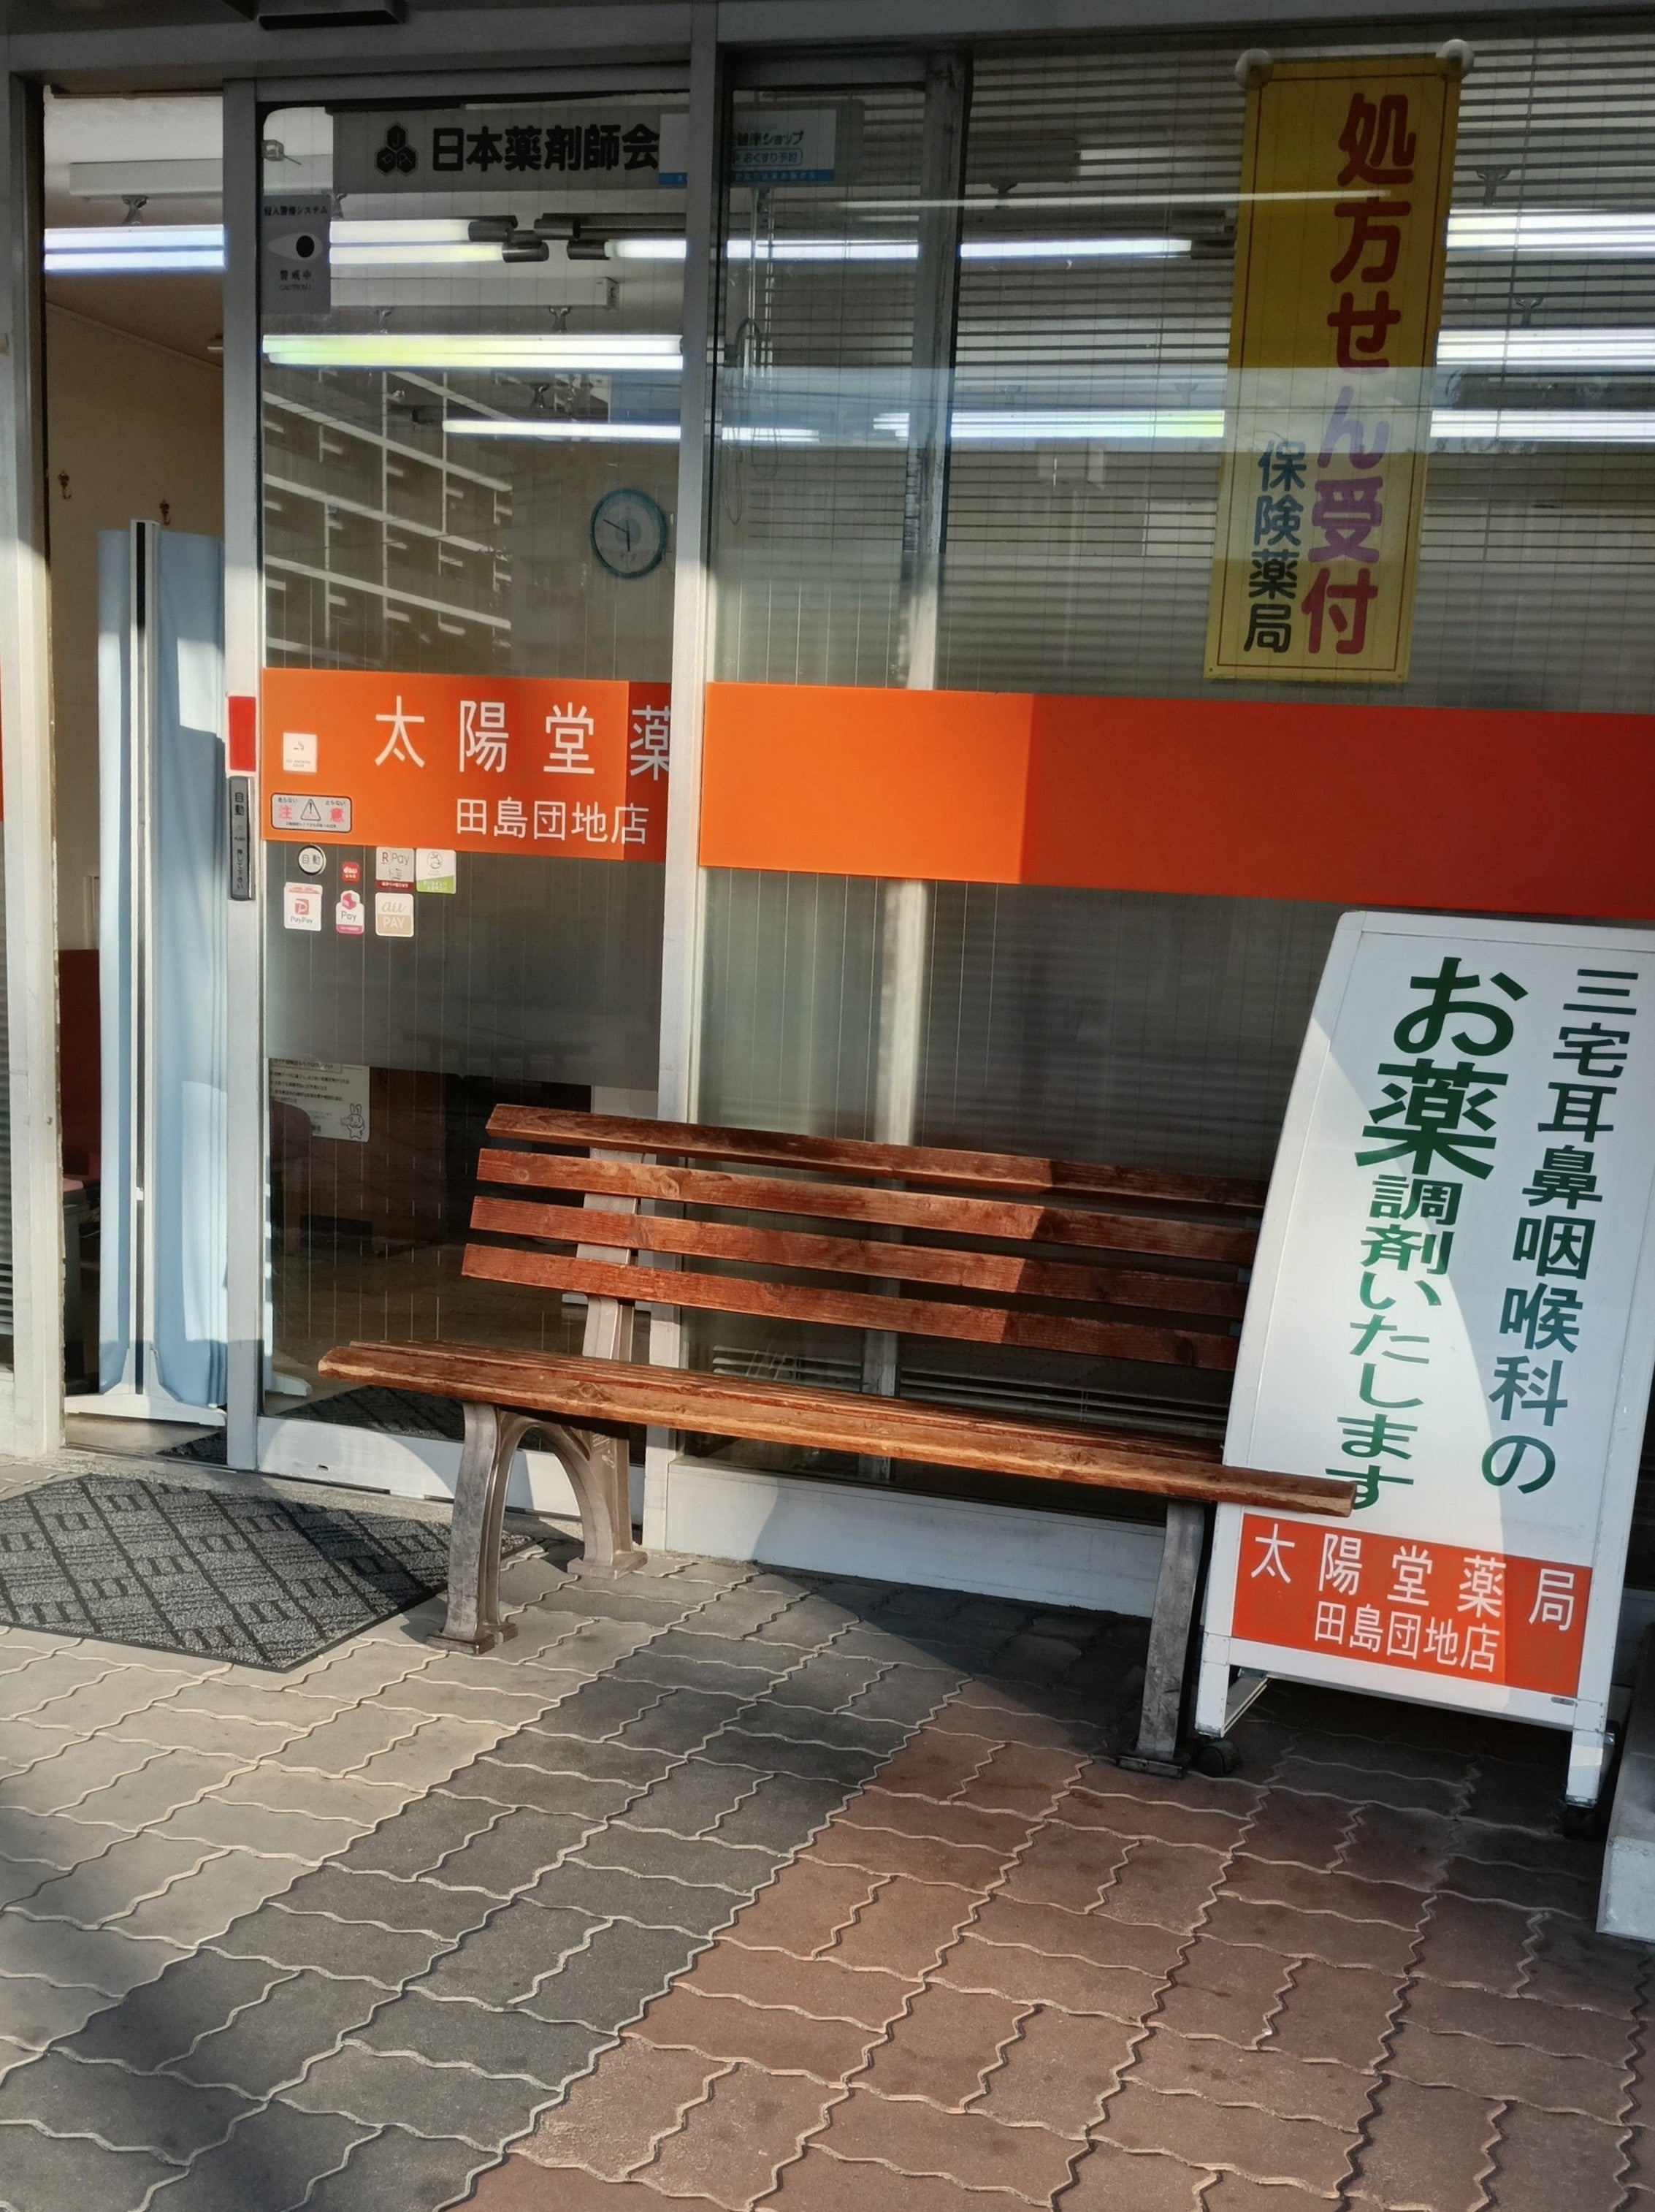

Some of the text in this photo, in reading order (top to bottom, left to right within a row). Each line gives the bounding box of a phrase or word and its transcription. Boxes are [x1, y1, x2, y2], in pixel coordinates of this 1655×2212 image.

[432, 123, 660, 172] 日本薬剤師会
[1301, 92, 1416, 655] 処方せん受付
[1243, 439, 1307, 653] 保険薬局
[374, 695, 670, 782] 太陽堂薬
[234, 792, 245, 816] 自動
[456, 796, 649, 845] 田島団地店
[302, 854, 321, 865] 自動
[391, 853, 410, 865] Pay
[290, 915, 313, 925] PayPay
[340, 910, 357, 923] Pay
[382, 901, 406, 913] au
[383, 916, 405, 928] PAY
[1482, 968, 1640, 1495] 三宅耳鼻咽喉科の
[1250, 1522, 1578, 1633] 太陽堂薬局
[1313, 1602, 1502, 1674] 田島団地店
